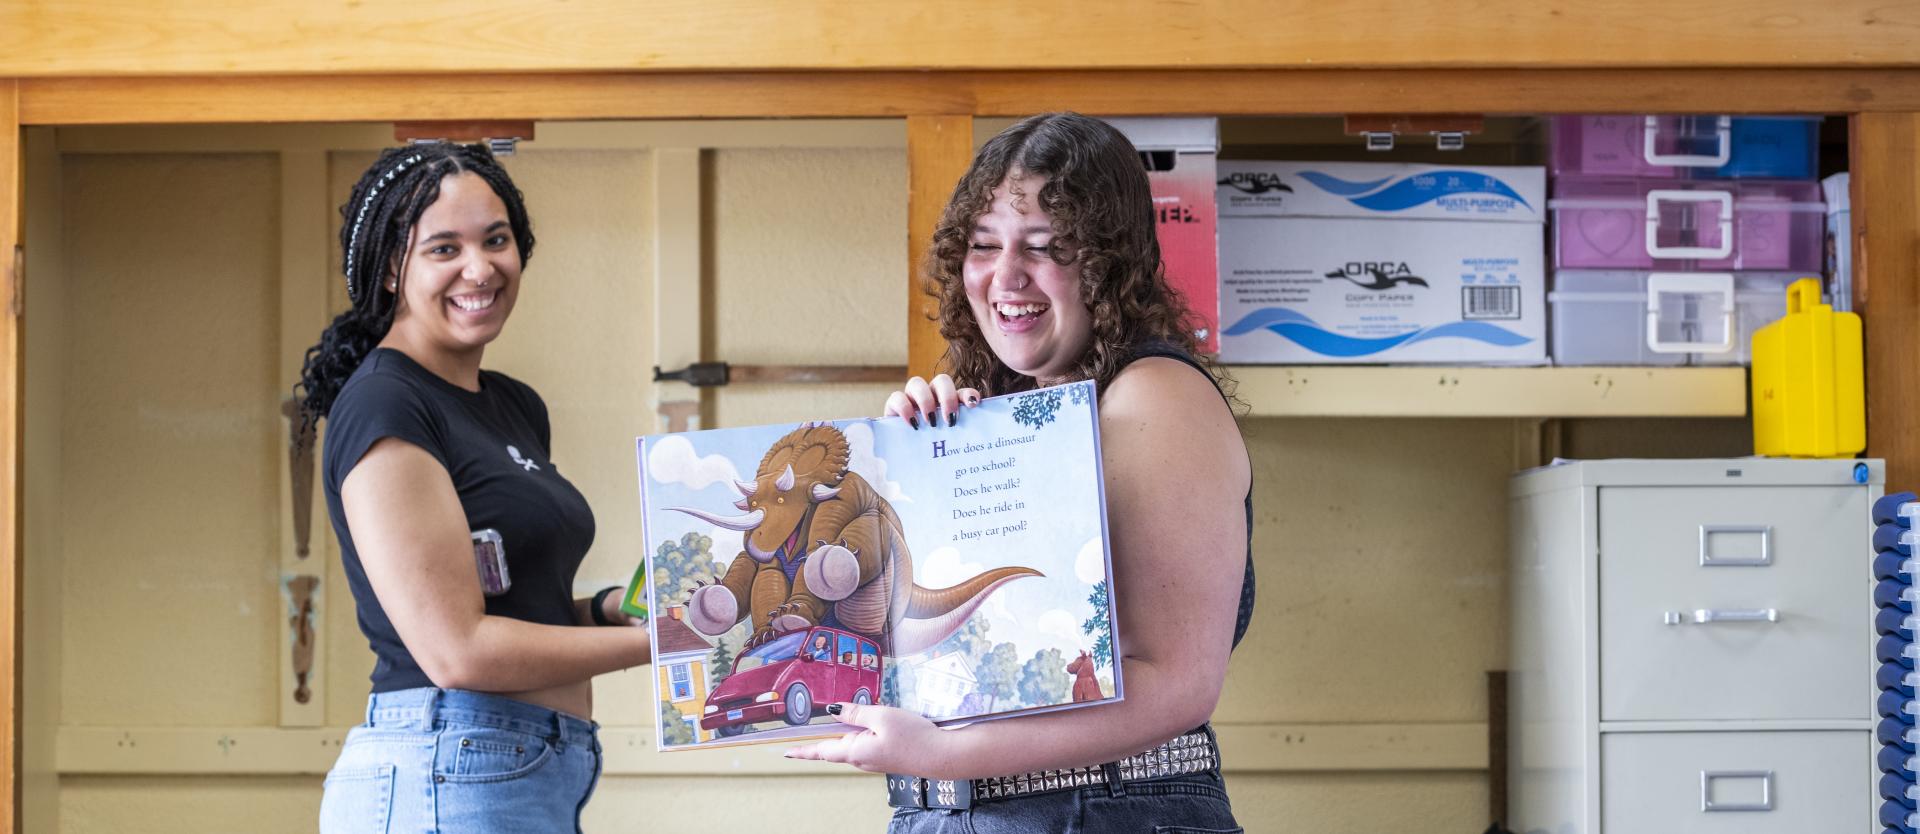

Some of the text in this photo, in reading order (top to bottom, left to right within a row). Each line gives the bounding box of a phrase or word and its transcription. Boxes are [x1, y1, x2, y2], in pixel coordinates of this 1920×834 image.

[1231, 172, 1281, 184] ORCA
[1436, 198, 1516, 209] MULTI-PURPOSE
[1345, 261, 1412, 276] ORCA
[932, 440, 960, 458] How
[963, 442, 985, 454] does
[995, 434, 1036, 448] dinosaur
[955, 457, 1016, 479] go to school?
[953, 478, 1021, 498] Does he walk?
[952, 500, 1025, 519] Does he ride in
[952, 520, 1028, 541] a busy car pool?
